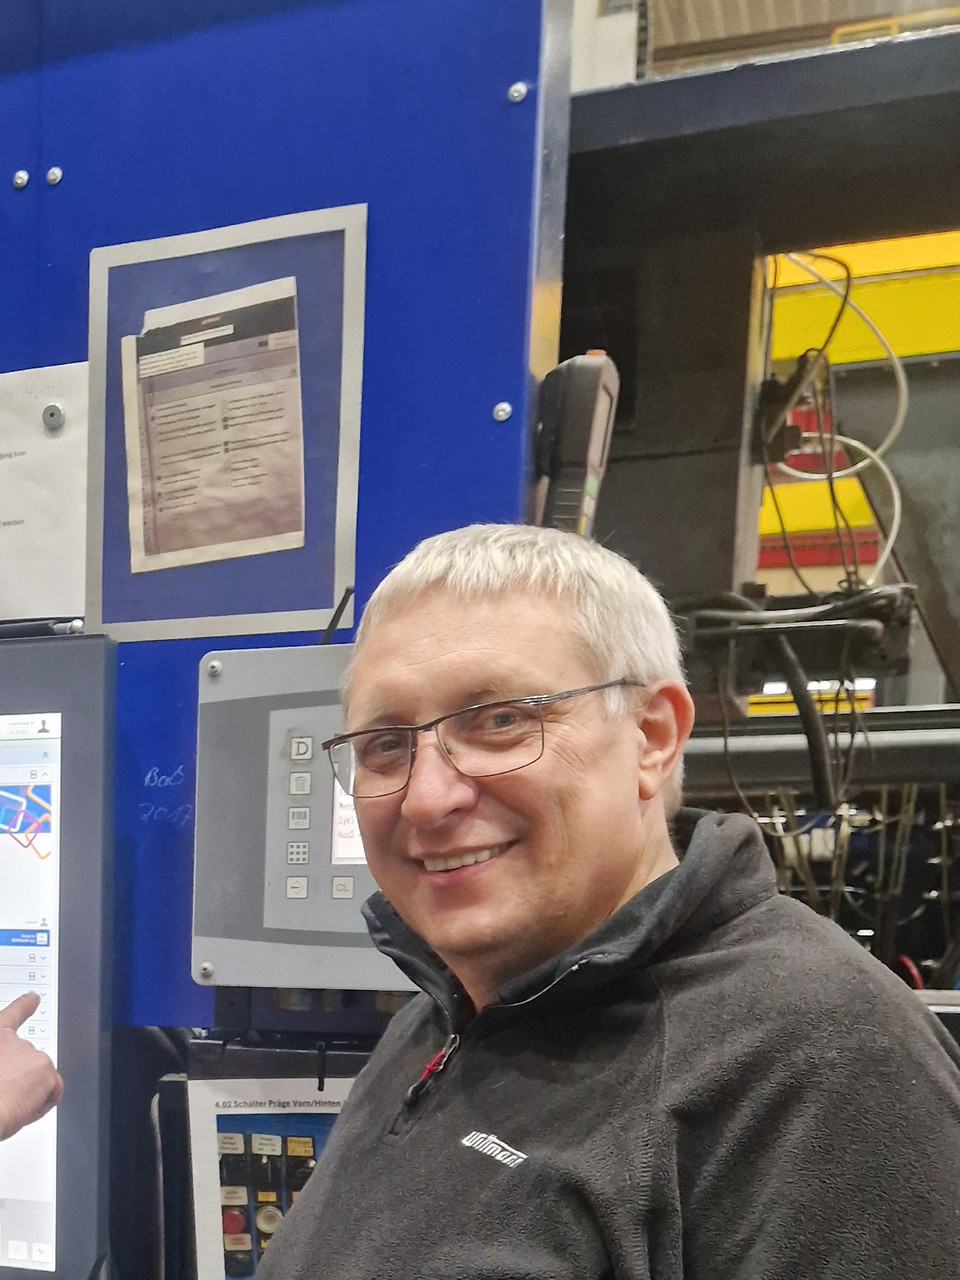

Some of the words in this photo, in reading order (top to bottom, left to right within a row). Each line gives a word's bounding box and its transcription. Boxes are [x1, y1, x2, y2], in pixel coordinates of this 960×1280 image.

[294, 741, 309, 756] D
[233, 1100, 266, 1108] Schalter
[268, 1099, 290, 1108] Präge
[292, 1099, 341, 1107] Vorn/Hinten
